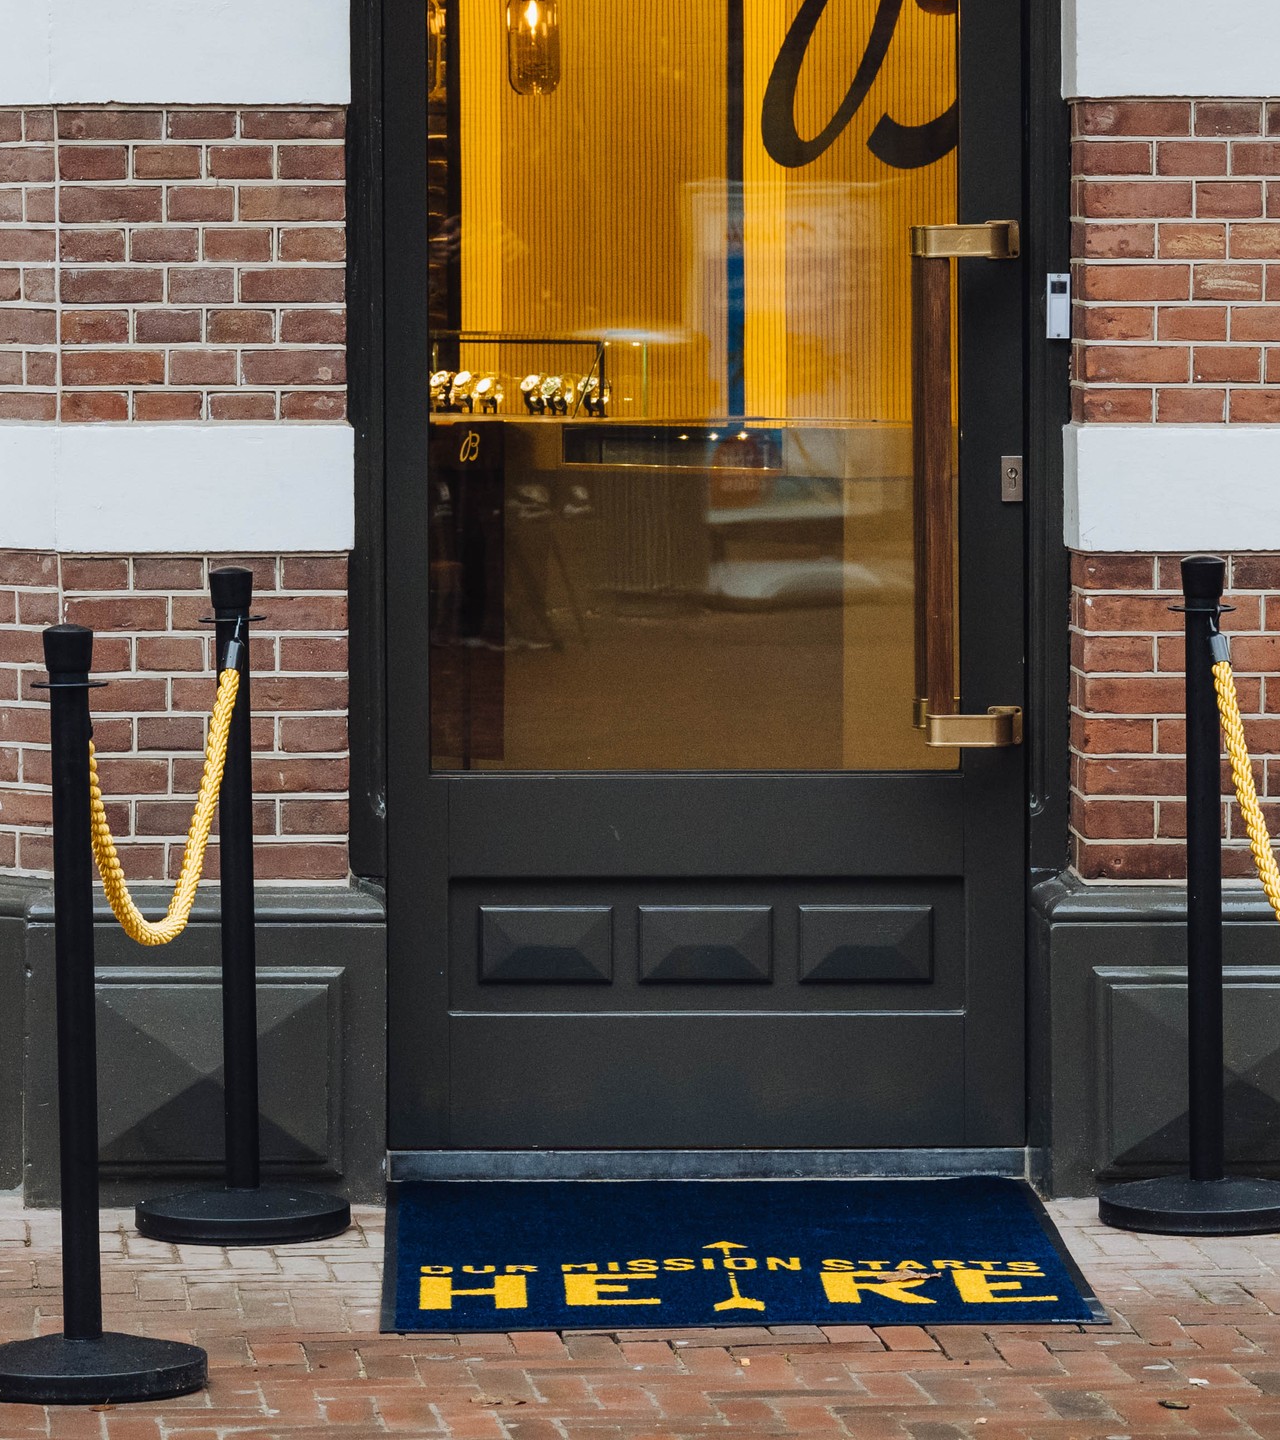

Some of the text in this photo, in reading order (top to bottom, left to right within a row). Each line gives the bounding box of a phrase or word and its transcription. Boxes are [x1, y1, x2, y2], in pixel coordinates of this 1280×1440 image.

[420, 1257, 1041, 1274] OUR MISSION STARTS
